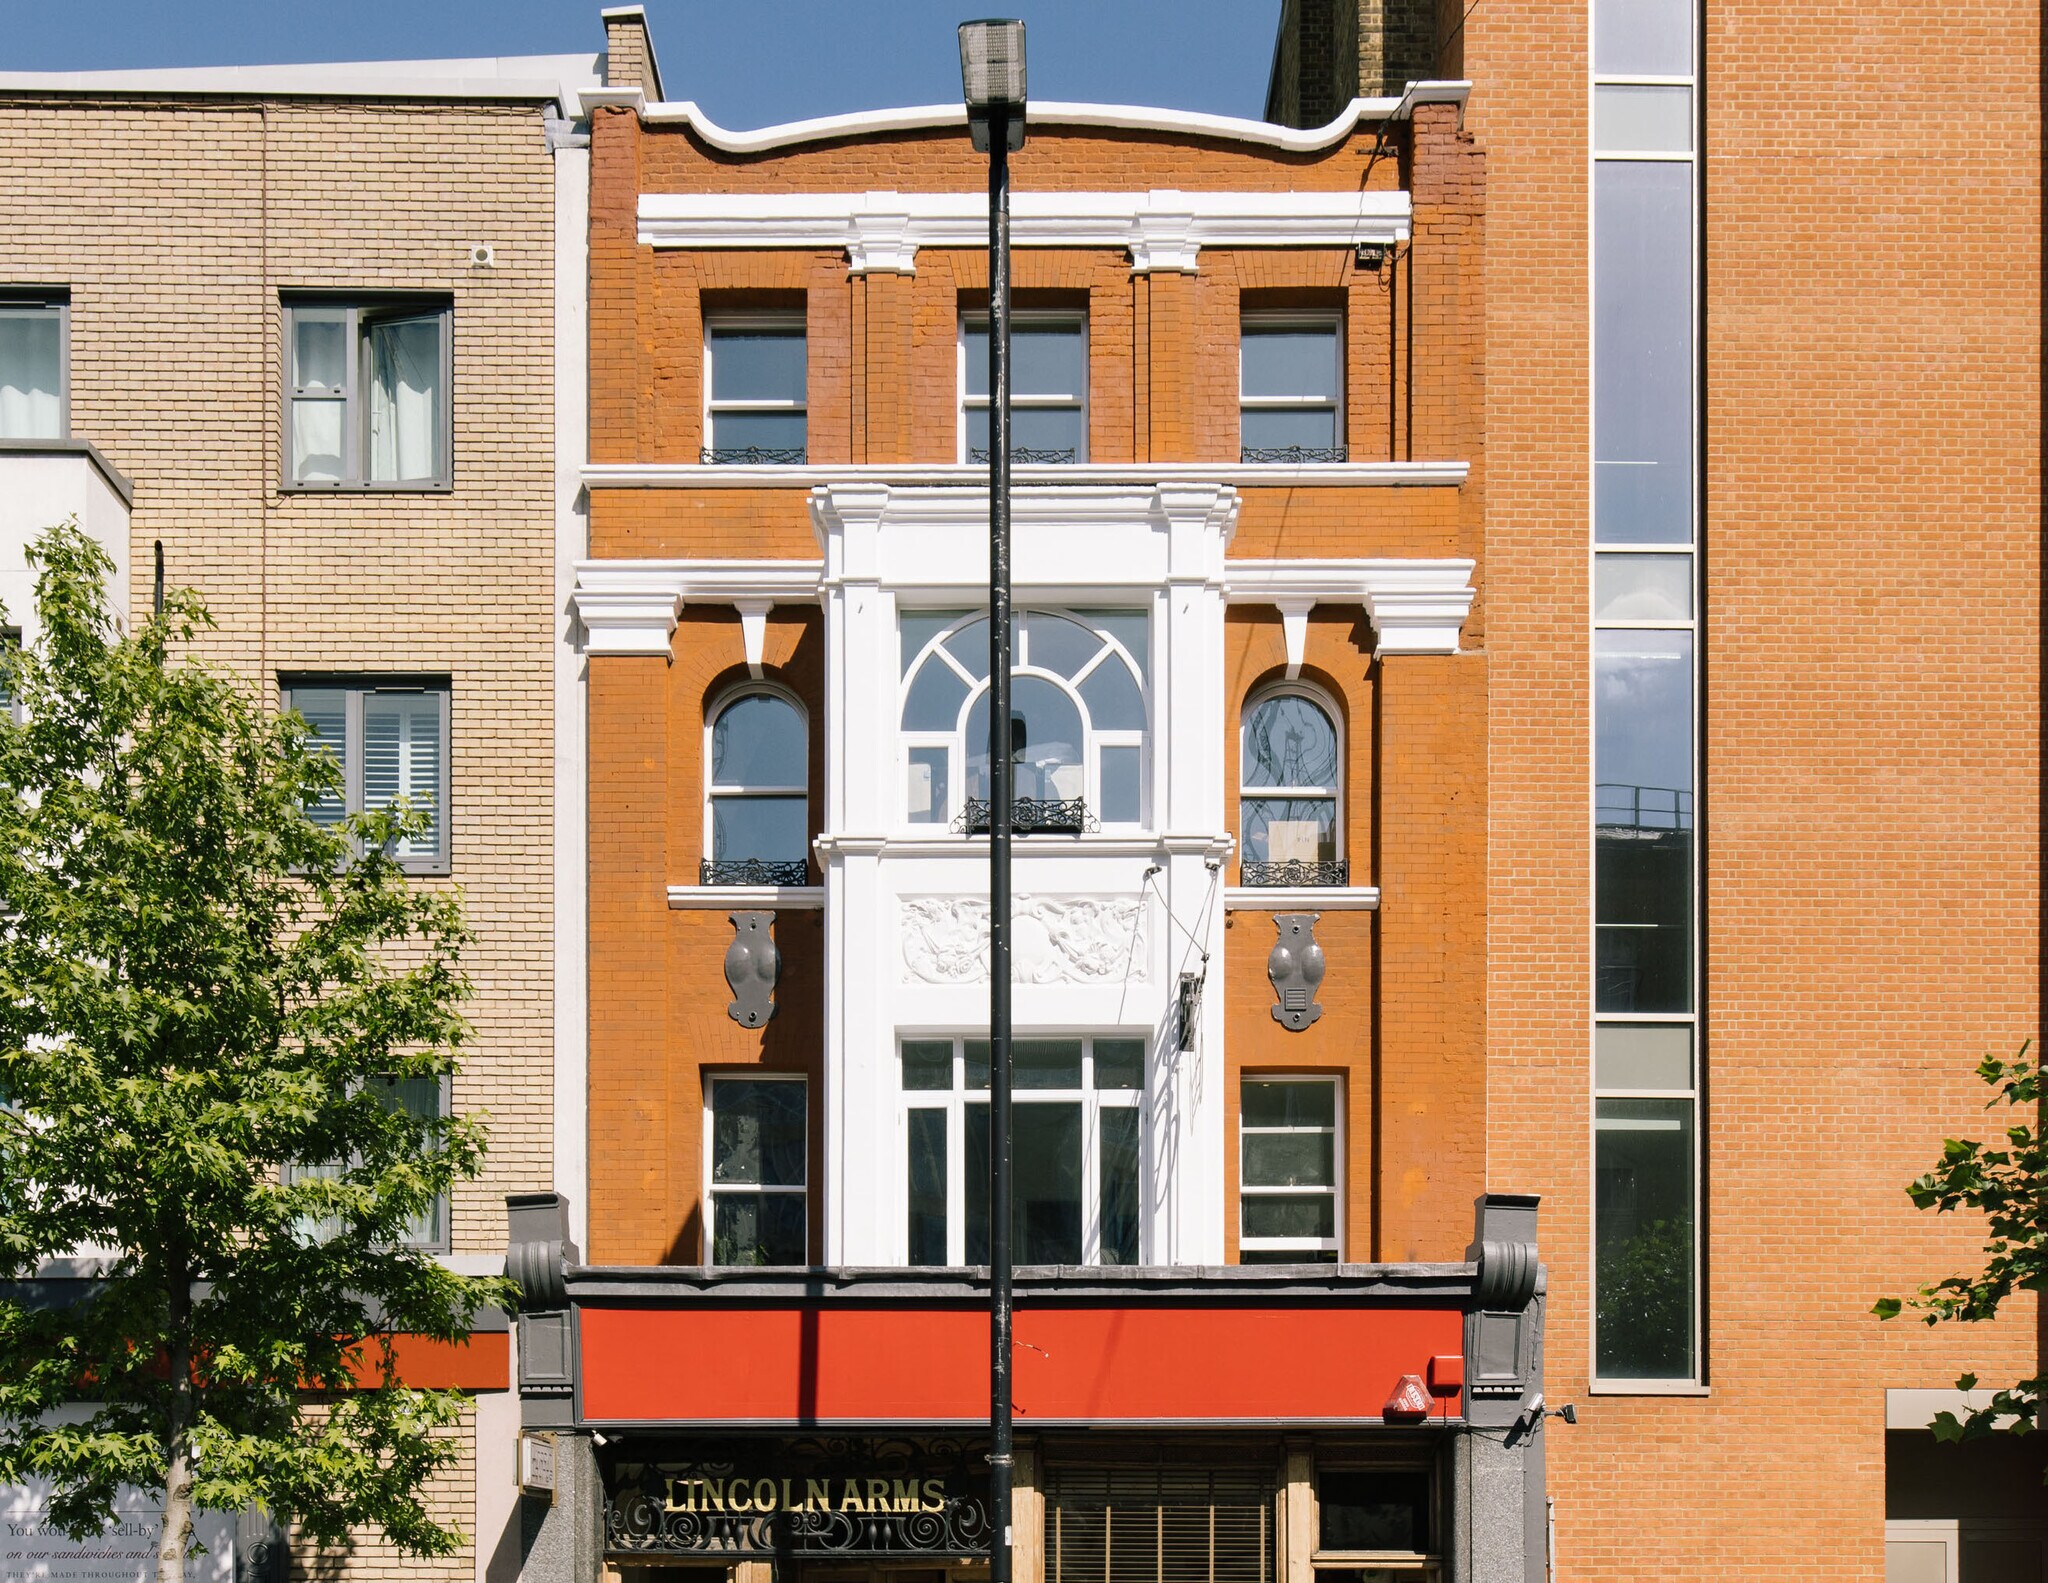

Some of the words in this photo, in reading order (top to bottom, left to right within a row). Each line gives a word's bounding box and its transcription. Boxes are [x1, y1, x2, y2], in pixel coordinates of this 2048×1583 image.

[664, 1478, 830, 1512] LINCOLN
[842, 1478, 946, 1513] ARMS
[7, 1523, 33, 1537] You
[37, 1526, 67, 1537] won
[6, 1551, 22, 1560] on
[26, 1551, 49, 1560] our
[51, 1545, 124, 1560] sandwiches
[125, 1545, 154, 1560] and
[51, 1571, 78, 1579] MADE
[81, 1571, 148, 1579] THROUGHOUT
